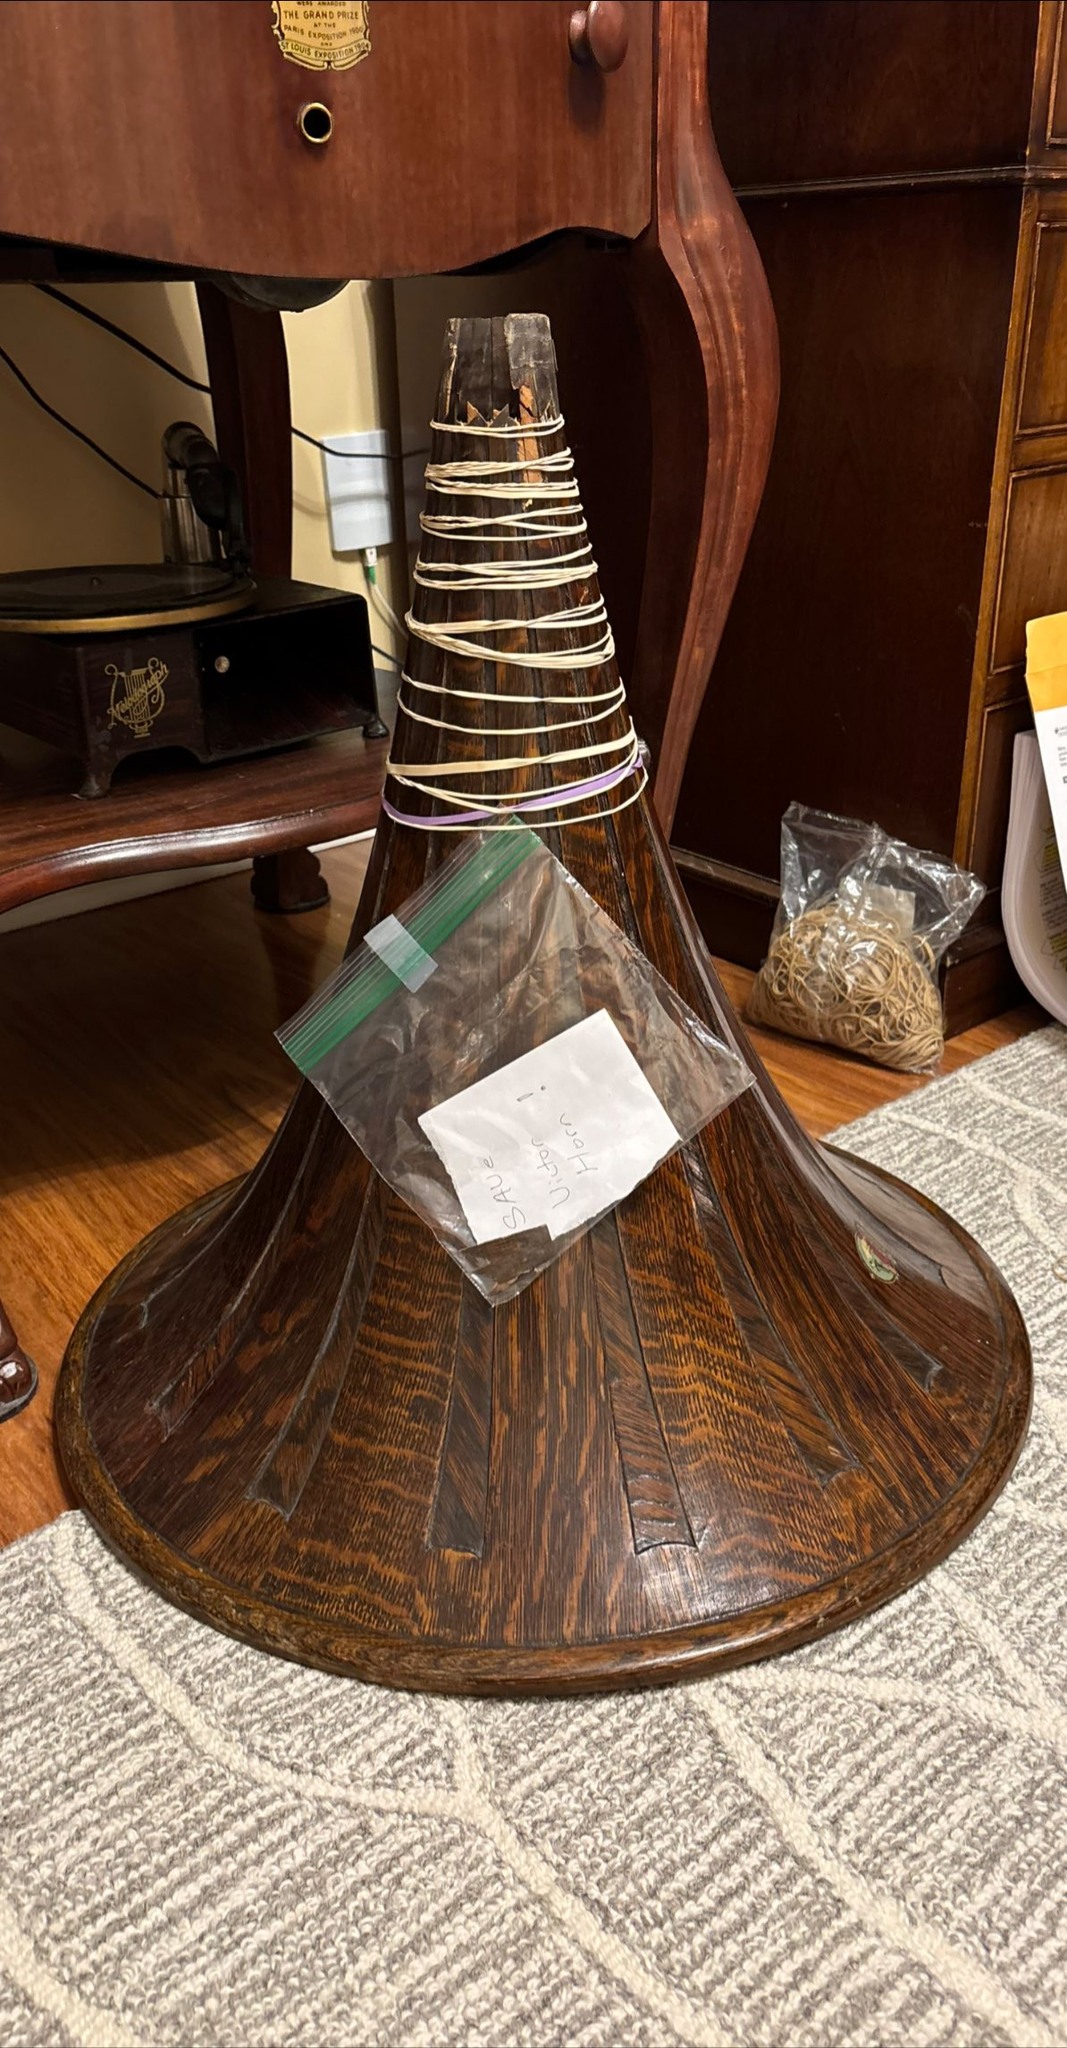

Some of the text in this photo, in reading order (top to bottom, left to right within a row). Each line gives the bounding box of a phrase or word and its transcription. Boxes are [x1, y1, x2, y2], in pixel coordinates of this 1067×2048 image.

[283, 10, 359, 20] THE GRAND PRIZE
[284, 24, 364, 40] PARIS EXPOSITION 1900
[281, 42, 289, 50] ST
[290, 43, 311, 56] LOUIS
[314, 47, 354, 59] EXPOSITION
[559, 1112, 598, 1175] Horn
